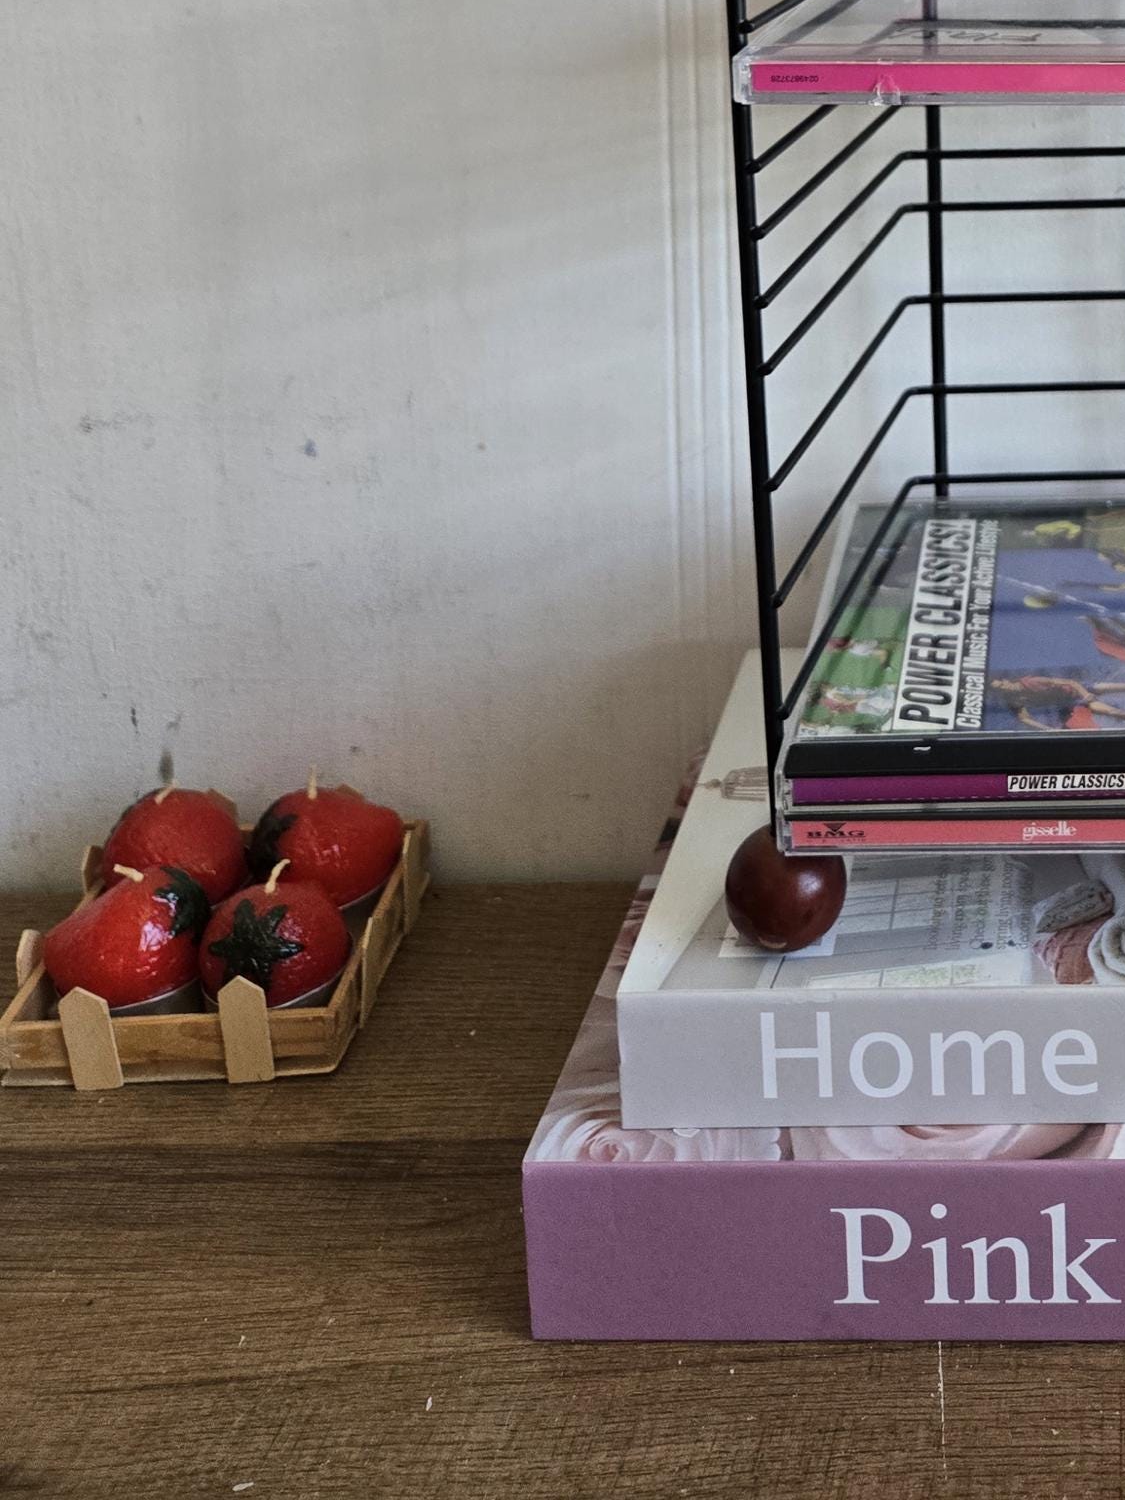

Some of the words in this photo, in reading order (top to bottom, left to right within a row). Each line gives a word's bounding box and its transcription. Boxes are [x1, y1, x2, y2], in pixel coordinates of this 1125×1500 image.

[914, 522, 972, 625] CLASSICS!
[971, 557, 995, 587] Active
[968, 587, 992, 611] Your
[966, 613, 990, 631] For
[962, 633, 988, 669] Music
[899, 632, 959, 725] POWER
[956, 670, 985, 728] Classical
[1009, 776, 1057, 790] POWER
[807, 830, 866, 838] BMG
[1022, 821, 1077, 840] gisselle
[760, 1010, 1099, 1099] Home
[830, 1202, 1122, 1304] Pink
